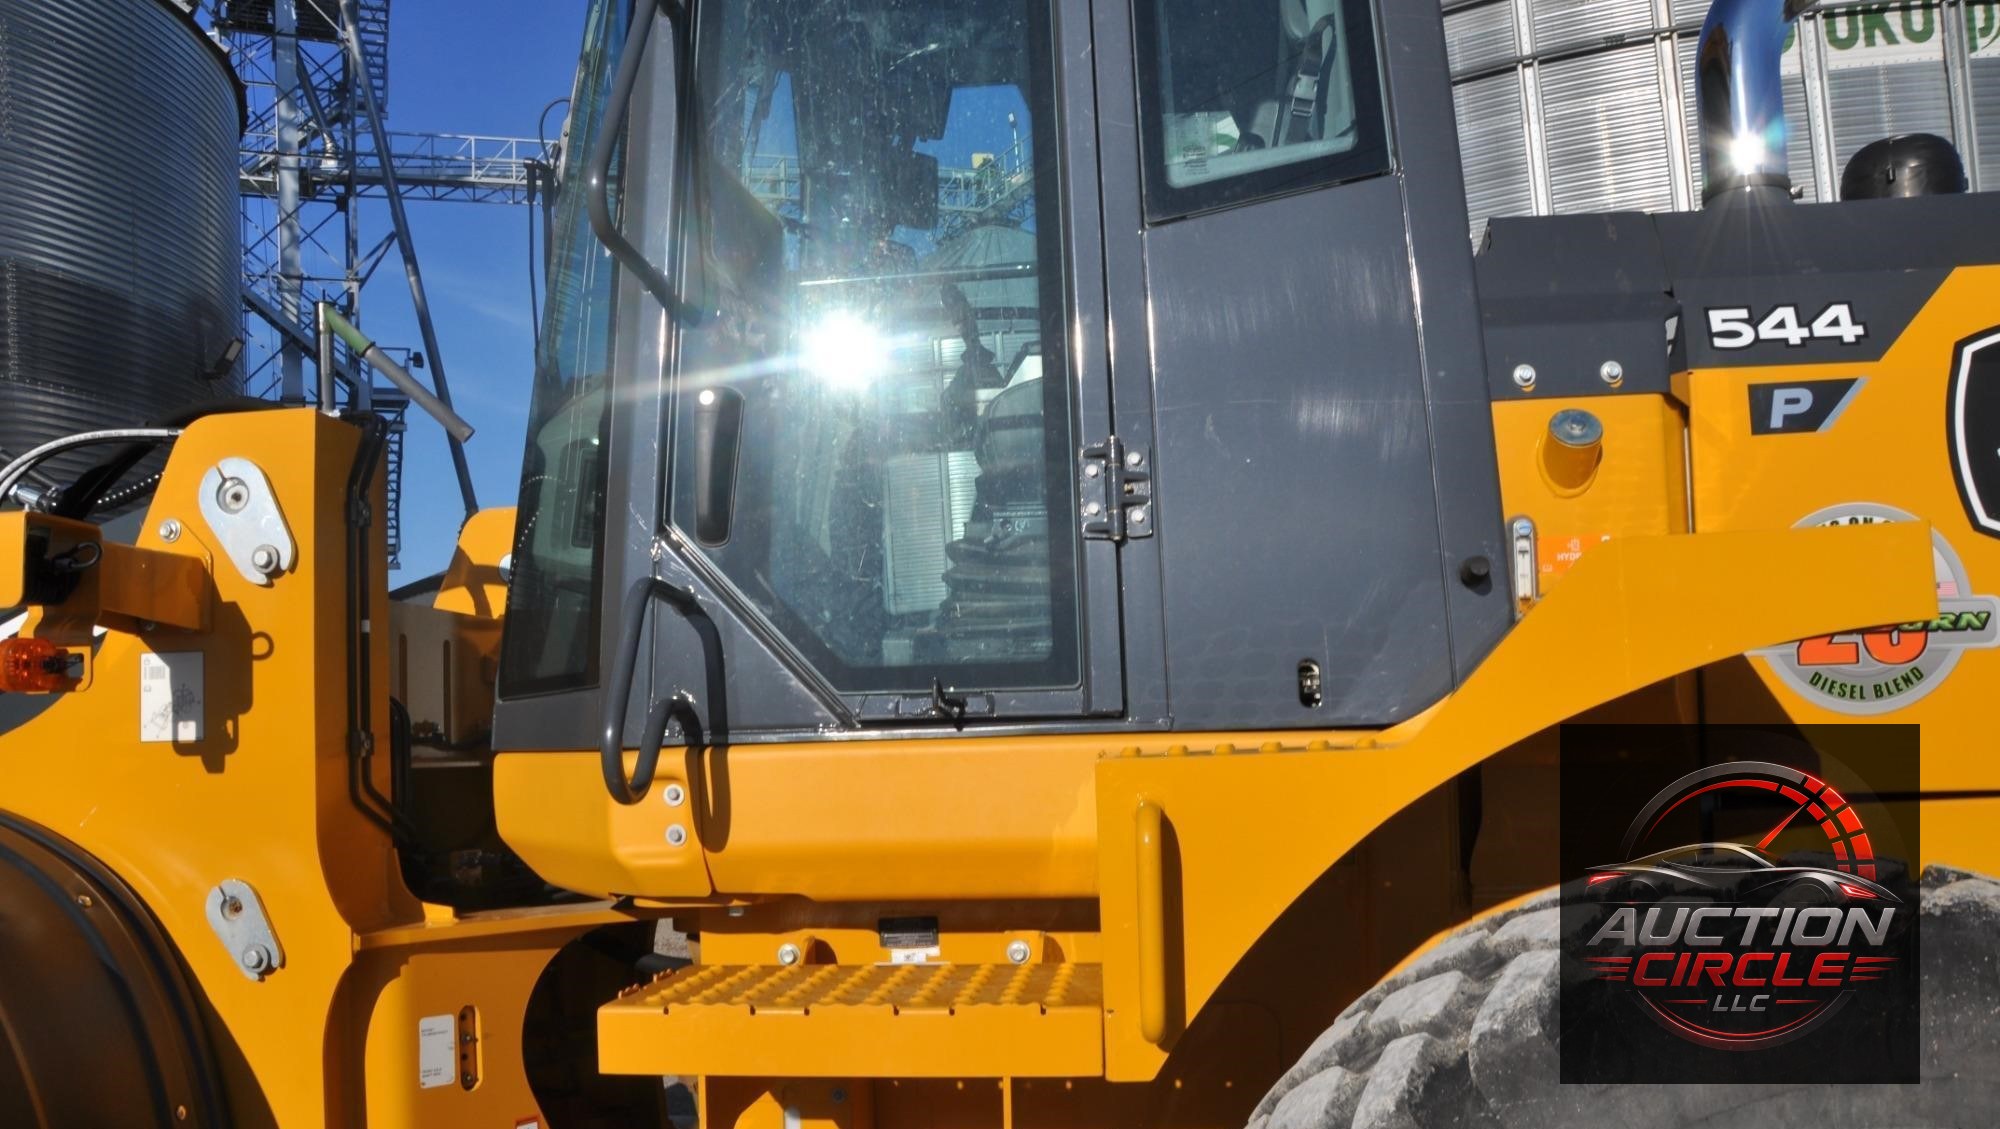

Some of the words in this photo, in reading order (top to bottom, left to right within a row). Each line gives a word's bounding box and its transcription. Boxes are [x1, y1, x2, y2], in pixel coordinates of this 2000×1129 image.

[1706, 303, 1866, 349] 544
[1770, 388, 1814, 429] P
[1808, 671, 1867, 700] DIESEL
[1873, 666, 1925, 699] BLEND
